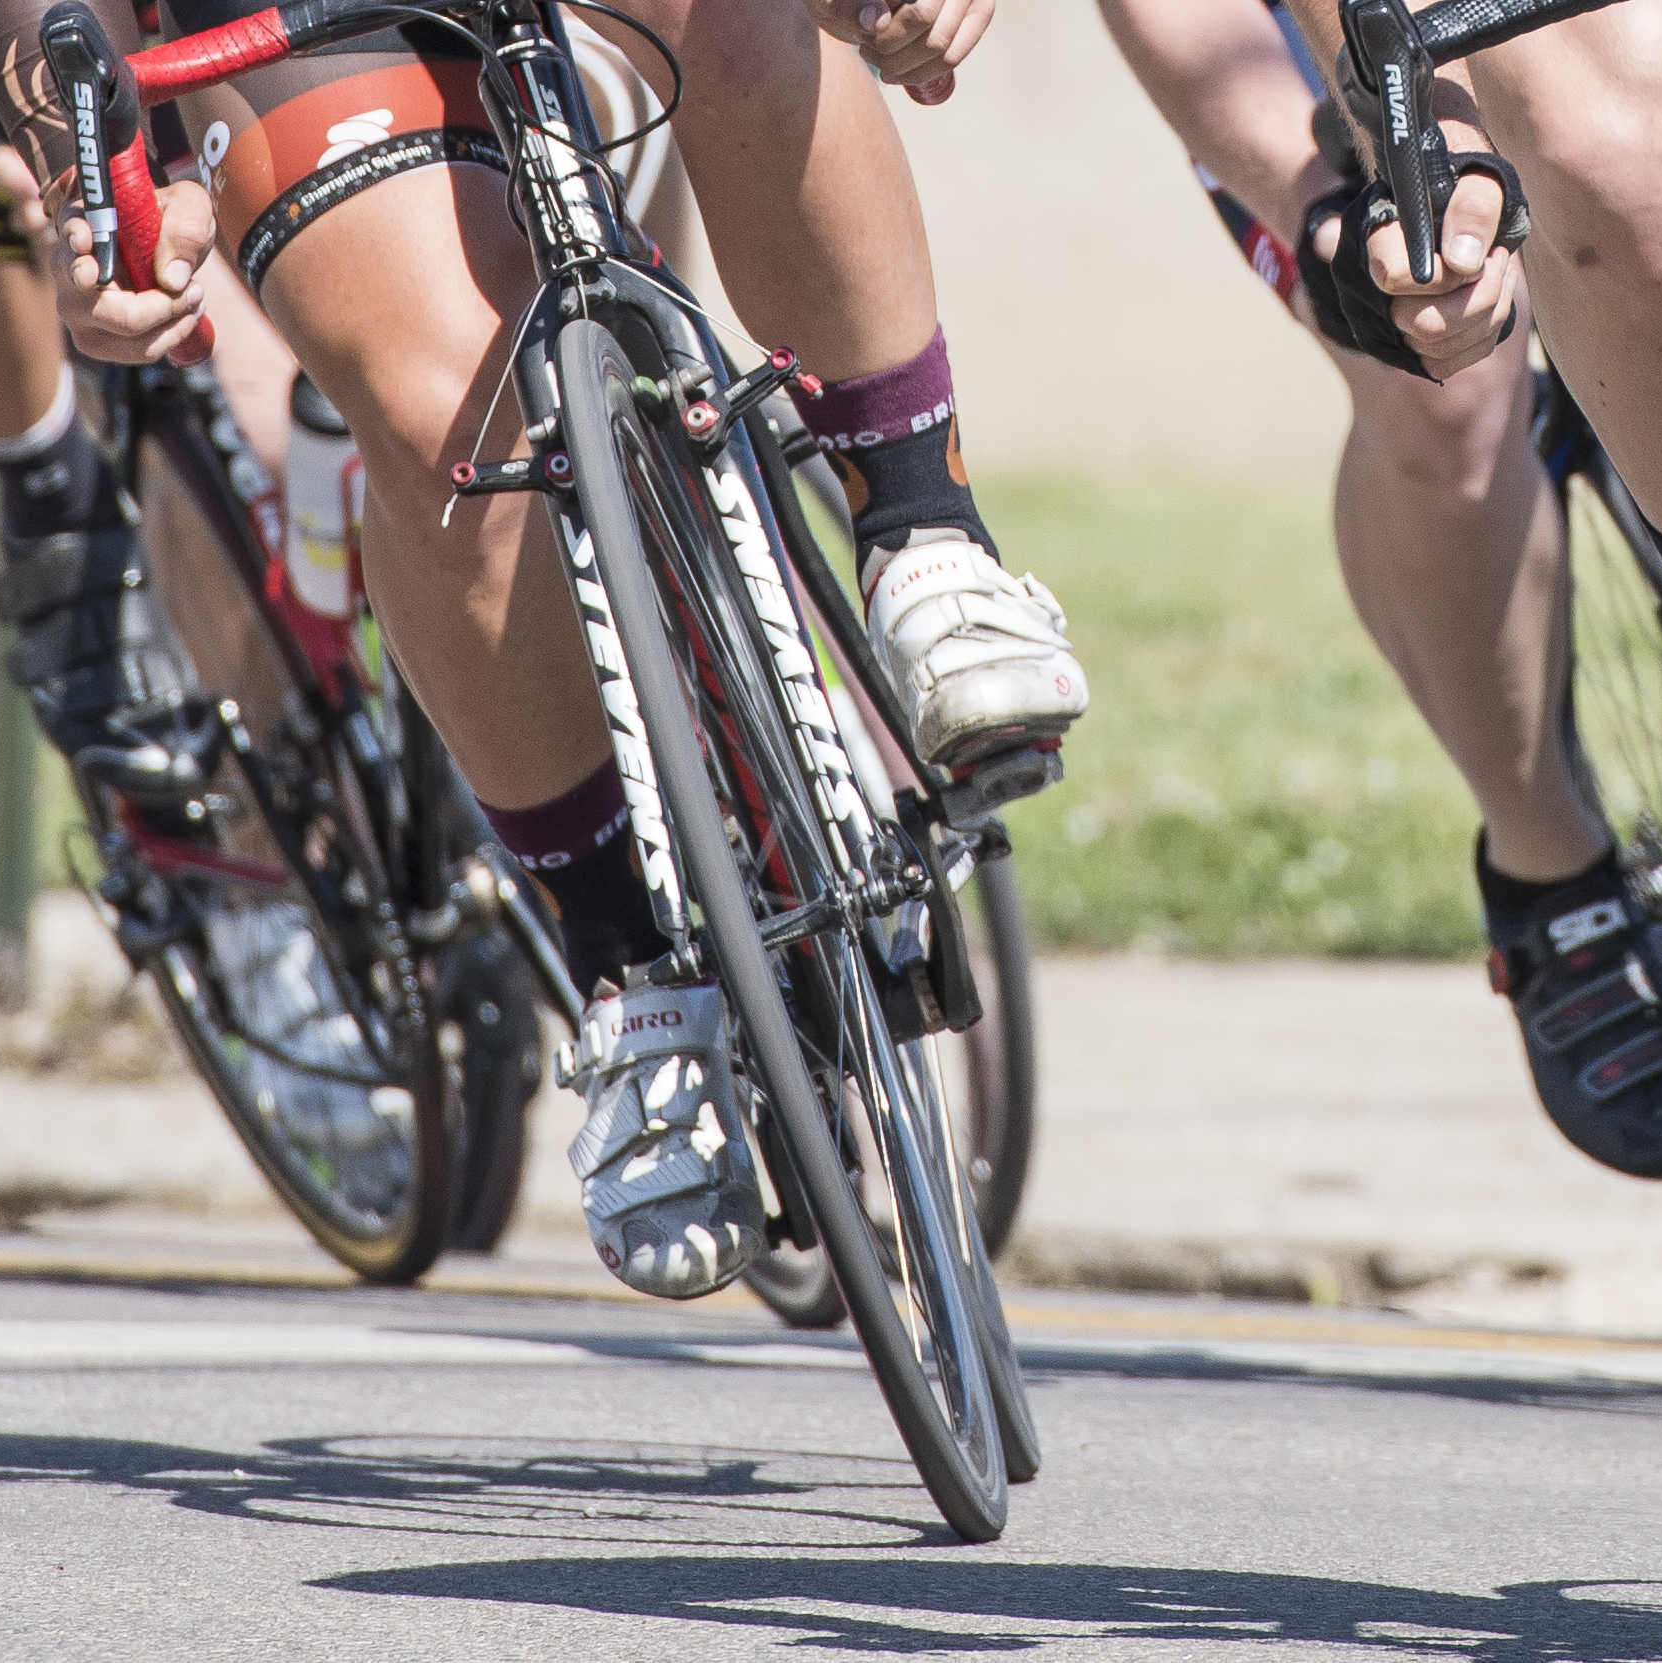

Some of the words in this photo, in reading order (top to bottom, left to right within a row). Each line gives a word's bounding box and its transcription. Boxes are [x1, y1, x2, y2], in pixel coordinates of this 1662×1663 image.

[74, 81, 104, 205] SRAM
[1384, 63, 1409, 147] RIVAL
[560, 513, 681, 904] STEVENS
[701, 465, 874, 838] STEVENS
